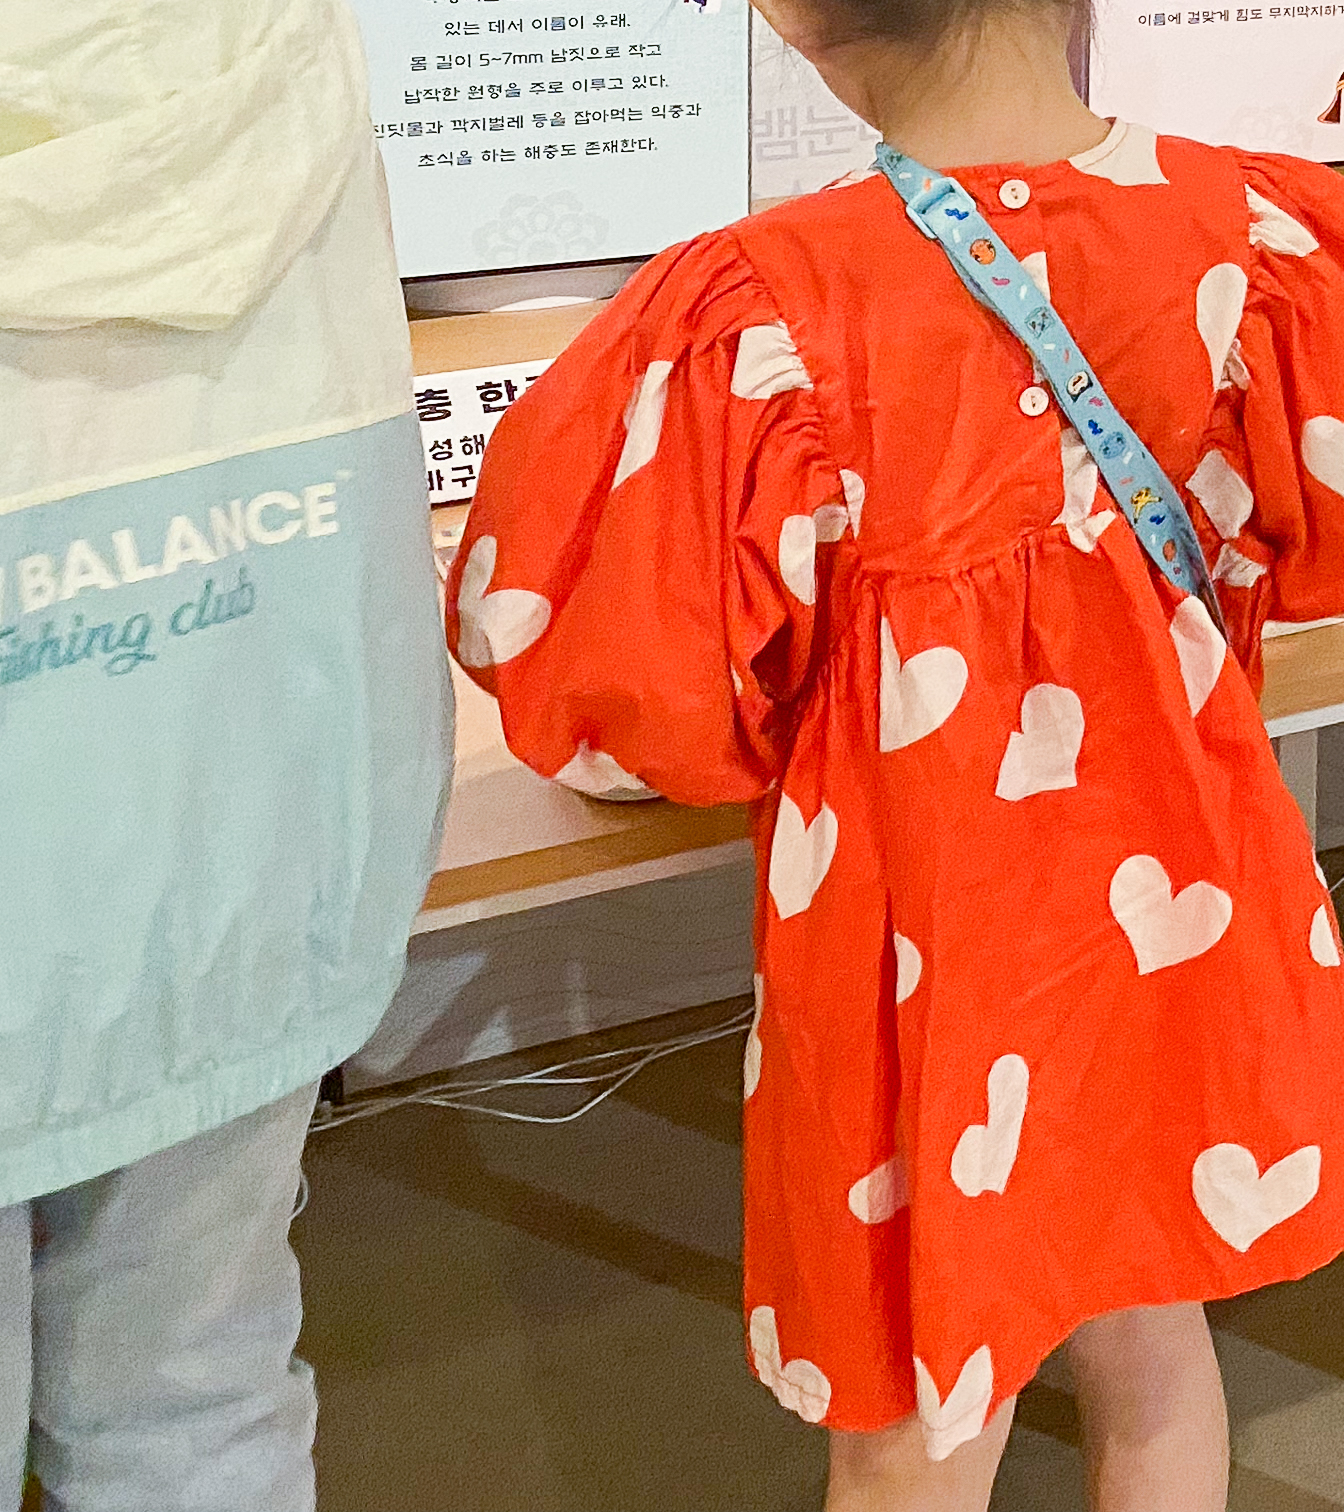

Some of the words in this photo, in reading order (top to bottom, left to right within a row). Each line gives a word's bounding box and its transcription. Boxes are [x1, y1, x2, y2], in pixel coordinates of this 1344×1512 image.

[445, 21, 480, 36] 있는
[488, 18, 523, 34] 데서
[531, 15, 584, 32] 이름이
[592, 13, 631, 29] 유래.
[410, 56, 427, 71] 몸
[436, 53, 471, 70] 길이
[479, 51, 543, 67] 5~7mm
[551, 45, 621, 63] 남짓으로
[628, 43, 662, 58] 작고
[404, 87, 460, 105] 납작한
[468, 83, 521, 100] 원형을
[529, 81, 564, 95] 주로
[572, 77, 624, 93] 이루고
[632, 74, 669, 89] 있다.
[532, 112, 566, 129] 등을
[574, 107, 643, 126] 잡아먹는
[418, 151, 473, 167] 초식을
[481, 148, 517, 163] 하는
[524, 144, 577, 160] 해충도
[585, 138, 658, 156] 존재한다.
[17, 482, 341, 614] BALANCE
